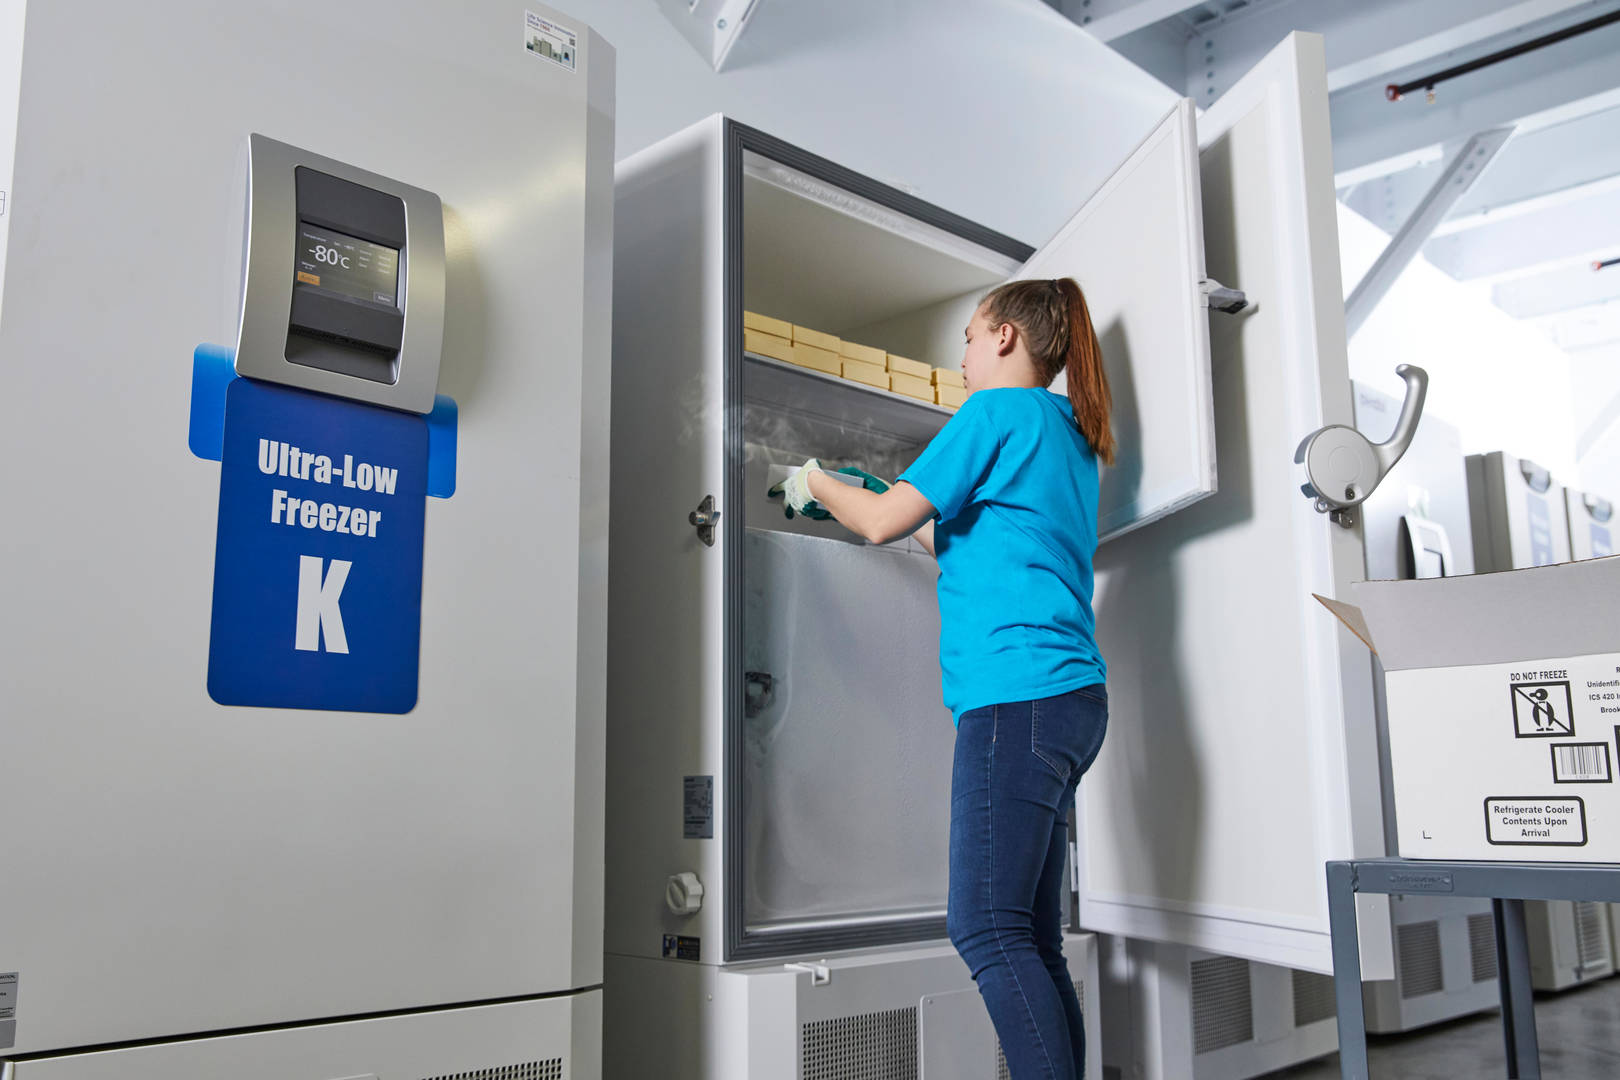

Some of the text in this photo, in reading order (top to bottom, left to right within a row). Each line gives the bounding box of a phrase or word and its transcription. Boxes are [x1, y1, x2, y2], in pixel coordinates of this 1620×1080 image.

[258, 438, 398, 495] Ultra-Low
[271, 489, 382, 538] Freezer
[295, 555, 352, 654] K
[1510, 670, 1568, 681] DO NOT FREEZE
[1589, 694, 1601, 702] ICS
[1494, 805, 1575, 815] Refrigerate Cooler
[1502, 817, 1568, 827] Contents Upon
[1521, 828, 1551, 837] Arrival
